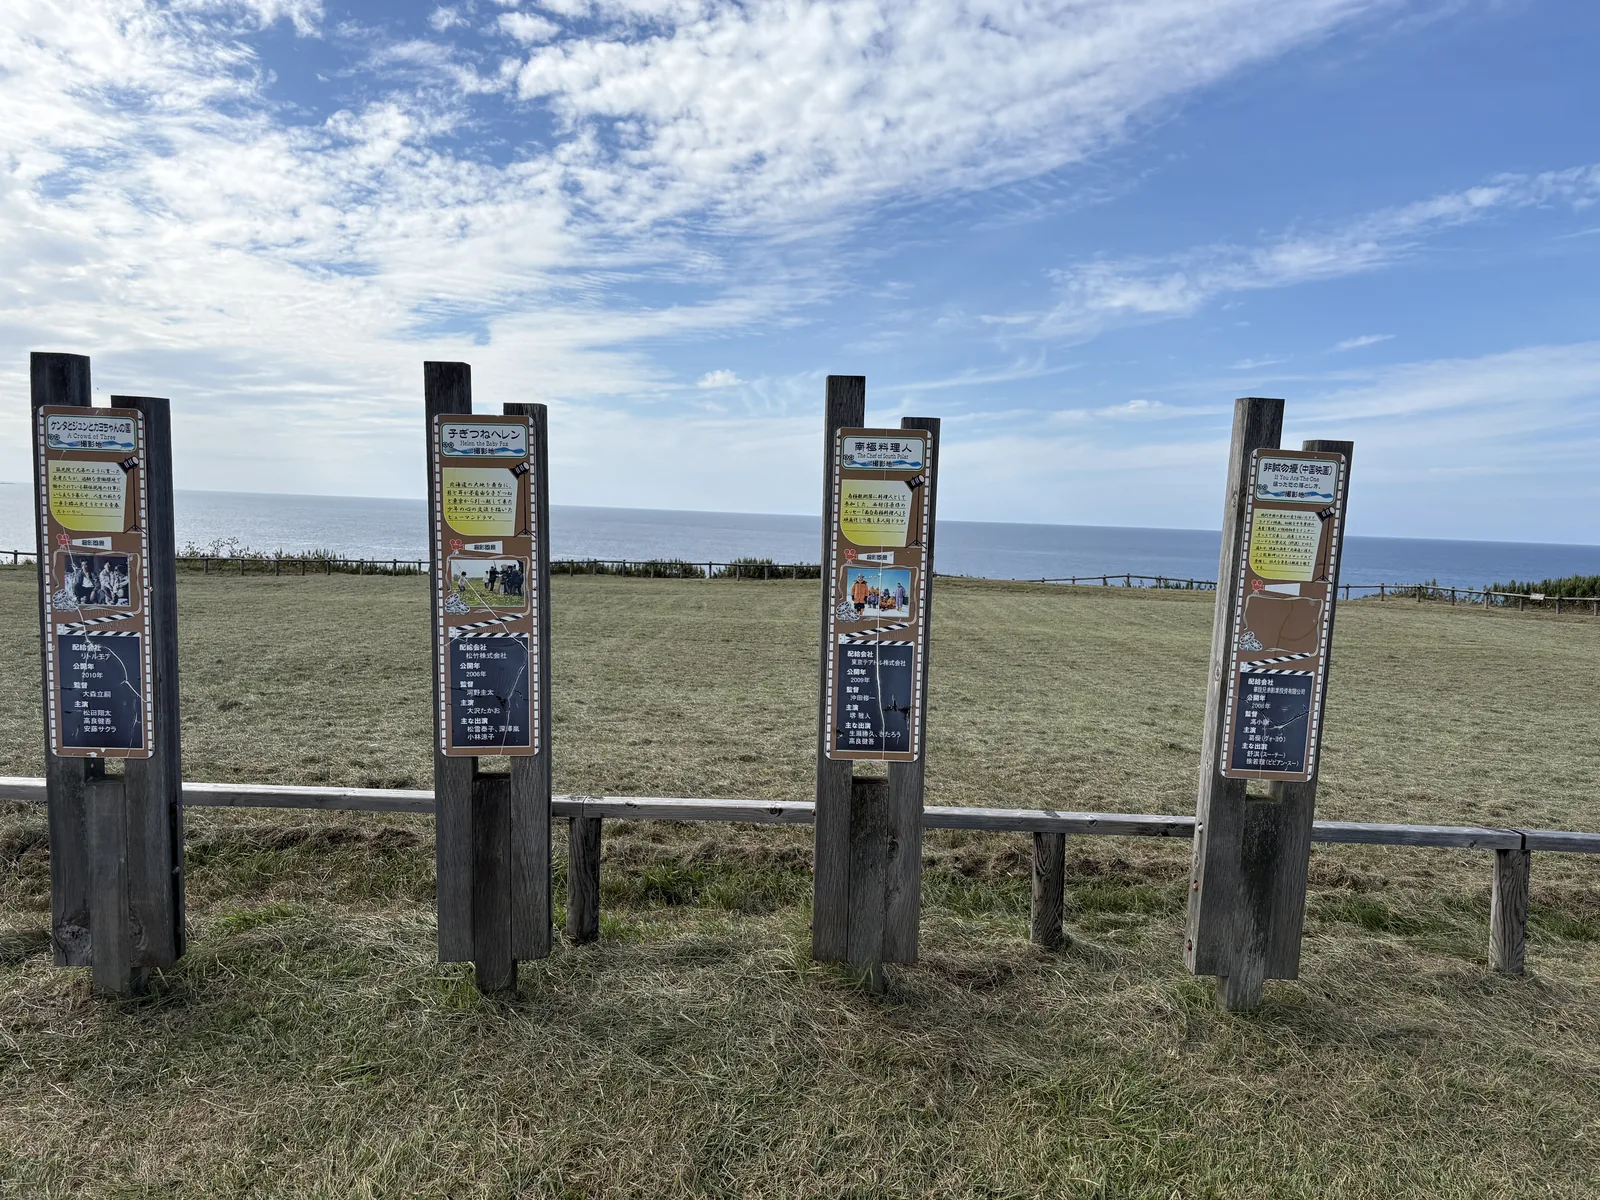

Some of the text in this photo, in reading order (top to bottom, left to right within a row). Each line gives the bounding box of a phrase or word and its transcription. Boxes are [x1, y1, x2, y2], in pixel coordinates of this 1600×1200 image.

[51, 421, 131, 433] ケンタとジュンとカヨちゃんの国
[448, 429, 520, 439] 子ぎつねヘレン
[855, 442, 912, 452] 南極料理人
[72, 643, 101, 651] 配給会社
[459, 644, 487, 652] 配給会社
[847, 650, 873, 658] 配給会社
[459, 662, 480, 670] 公開年
[1247, 694, 1265, 702] 公開年
[74, 700, 88, 708] 主演
[460, 699, 474, 707] 主演
[83, 709, 112, 717] 松田翔太
